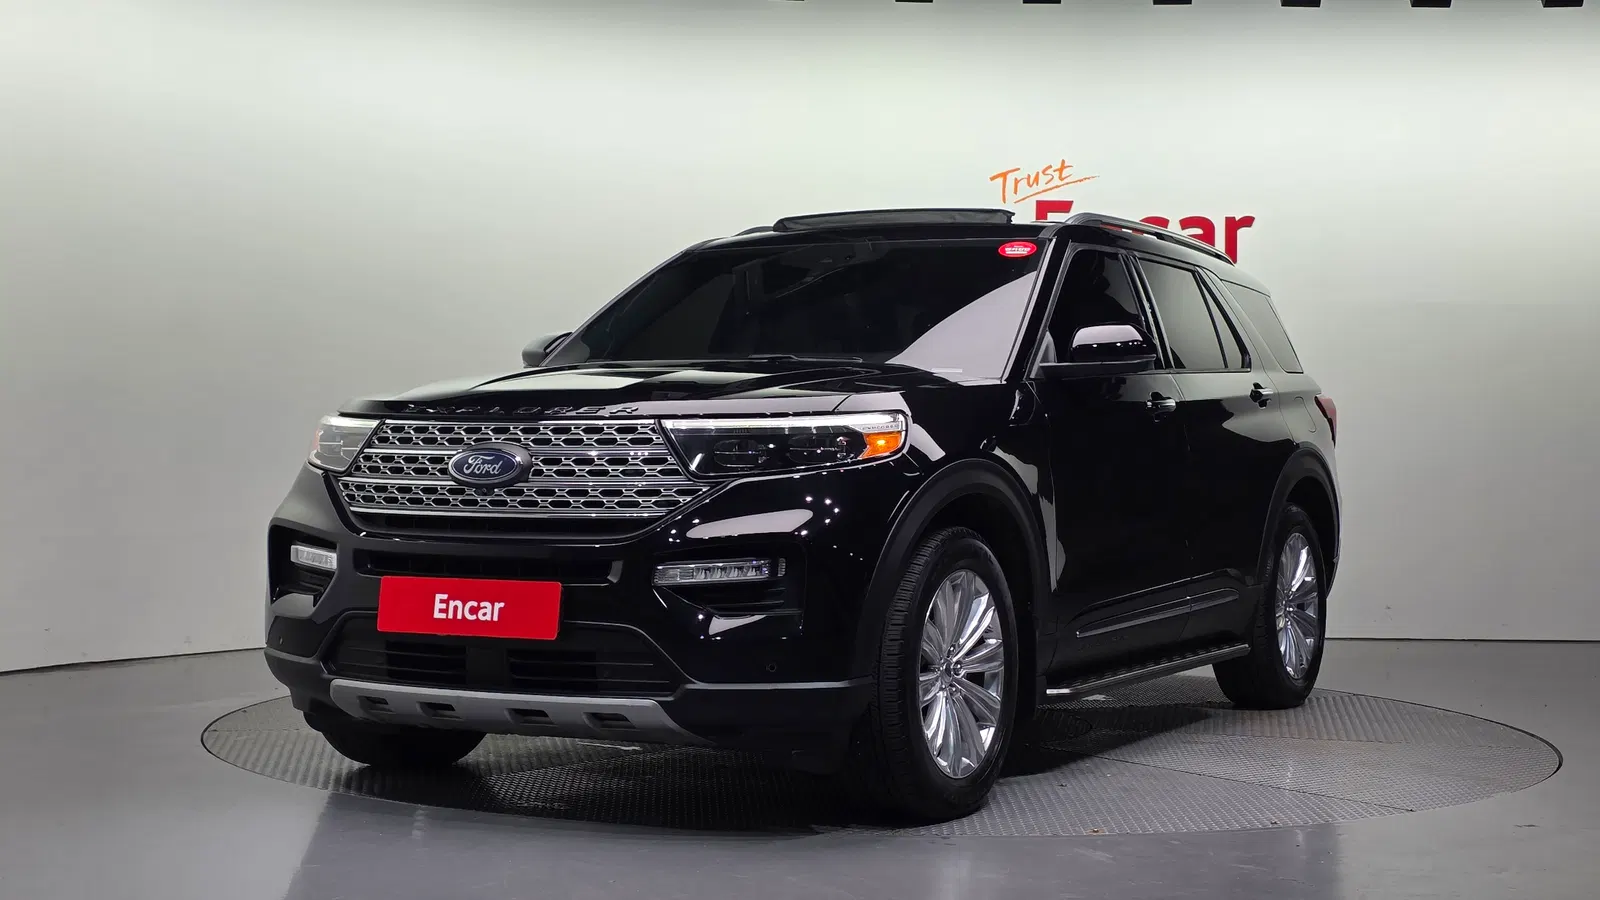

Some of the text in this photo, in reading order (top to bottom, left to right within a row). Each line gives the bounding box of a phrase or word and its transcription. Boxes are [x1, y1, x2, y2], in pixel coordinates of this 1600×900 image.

[989, 159, 1074, 204] Trust
[463, 454, 503, 474] Ford
[433, 593, 505, 622] Encar
